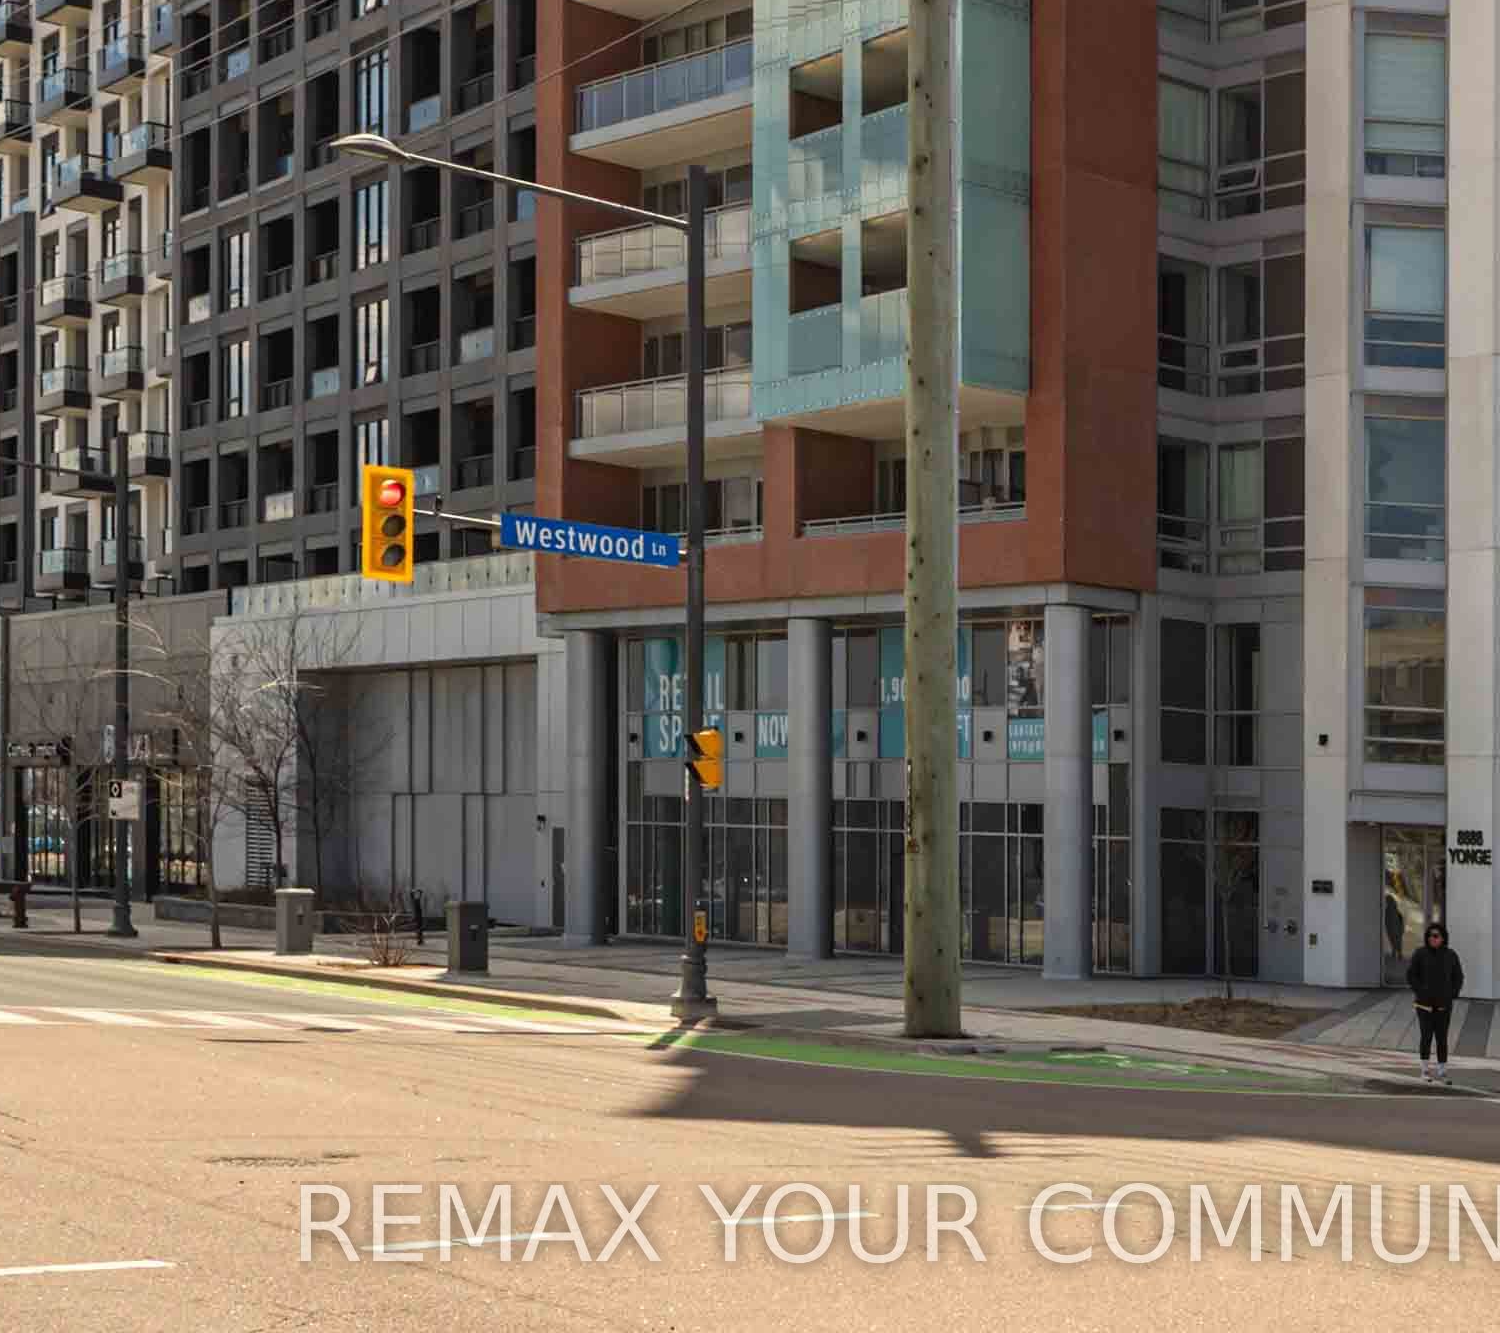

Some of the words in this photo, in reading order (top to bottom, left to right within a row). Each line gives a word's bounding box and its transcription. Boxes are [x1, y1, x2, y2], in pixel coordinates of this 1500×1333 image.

[515, 520, 645, 560] Westwood
[651, 541, 667, 558] Ln
[659, 673, 724, 711] REIL
[1448, 848, 1493, 865] YONGE
